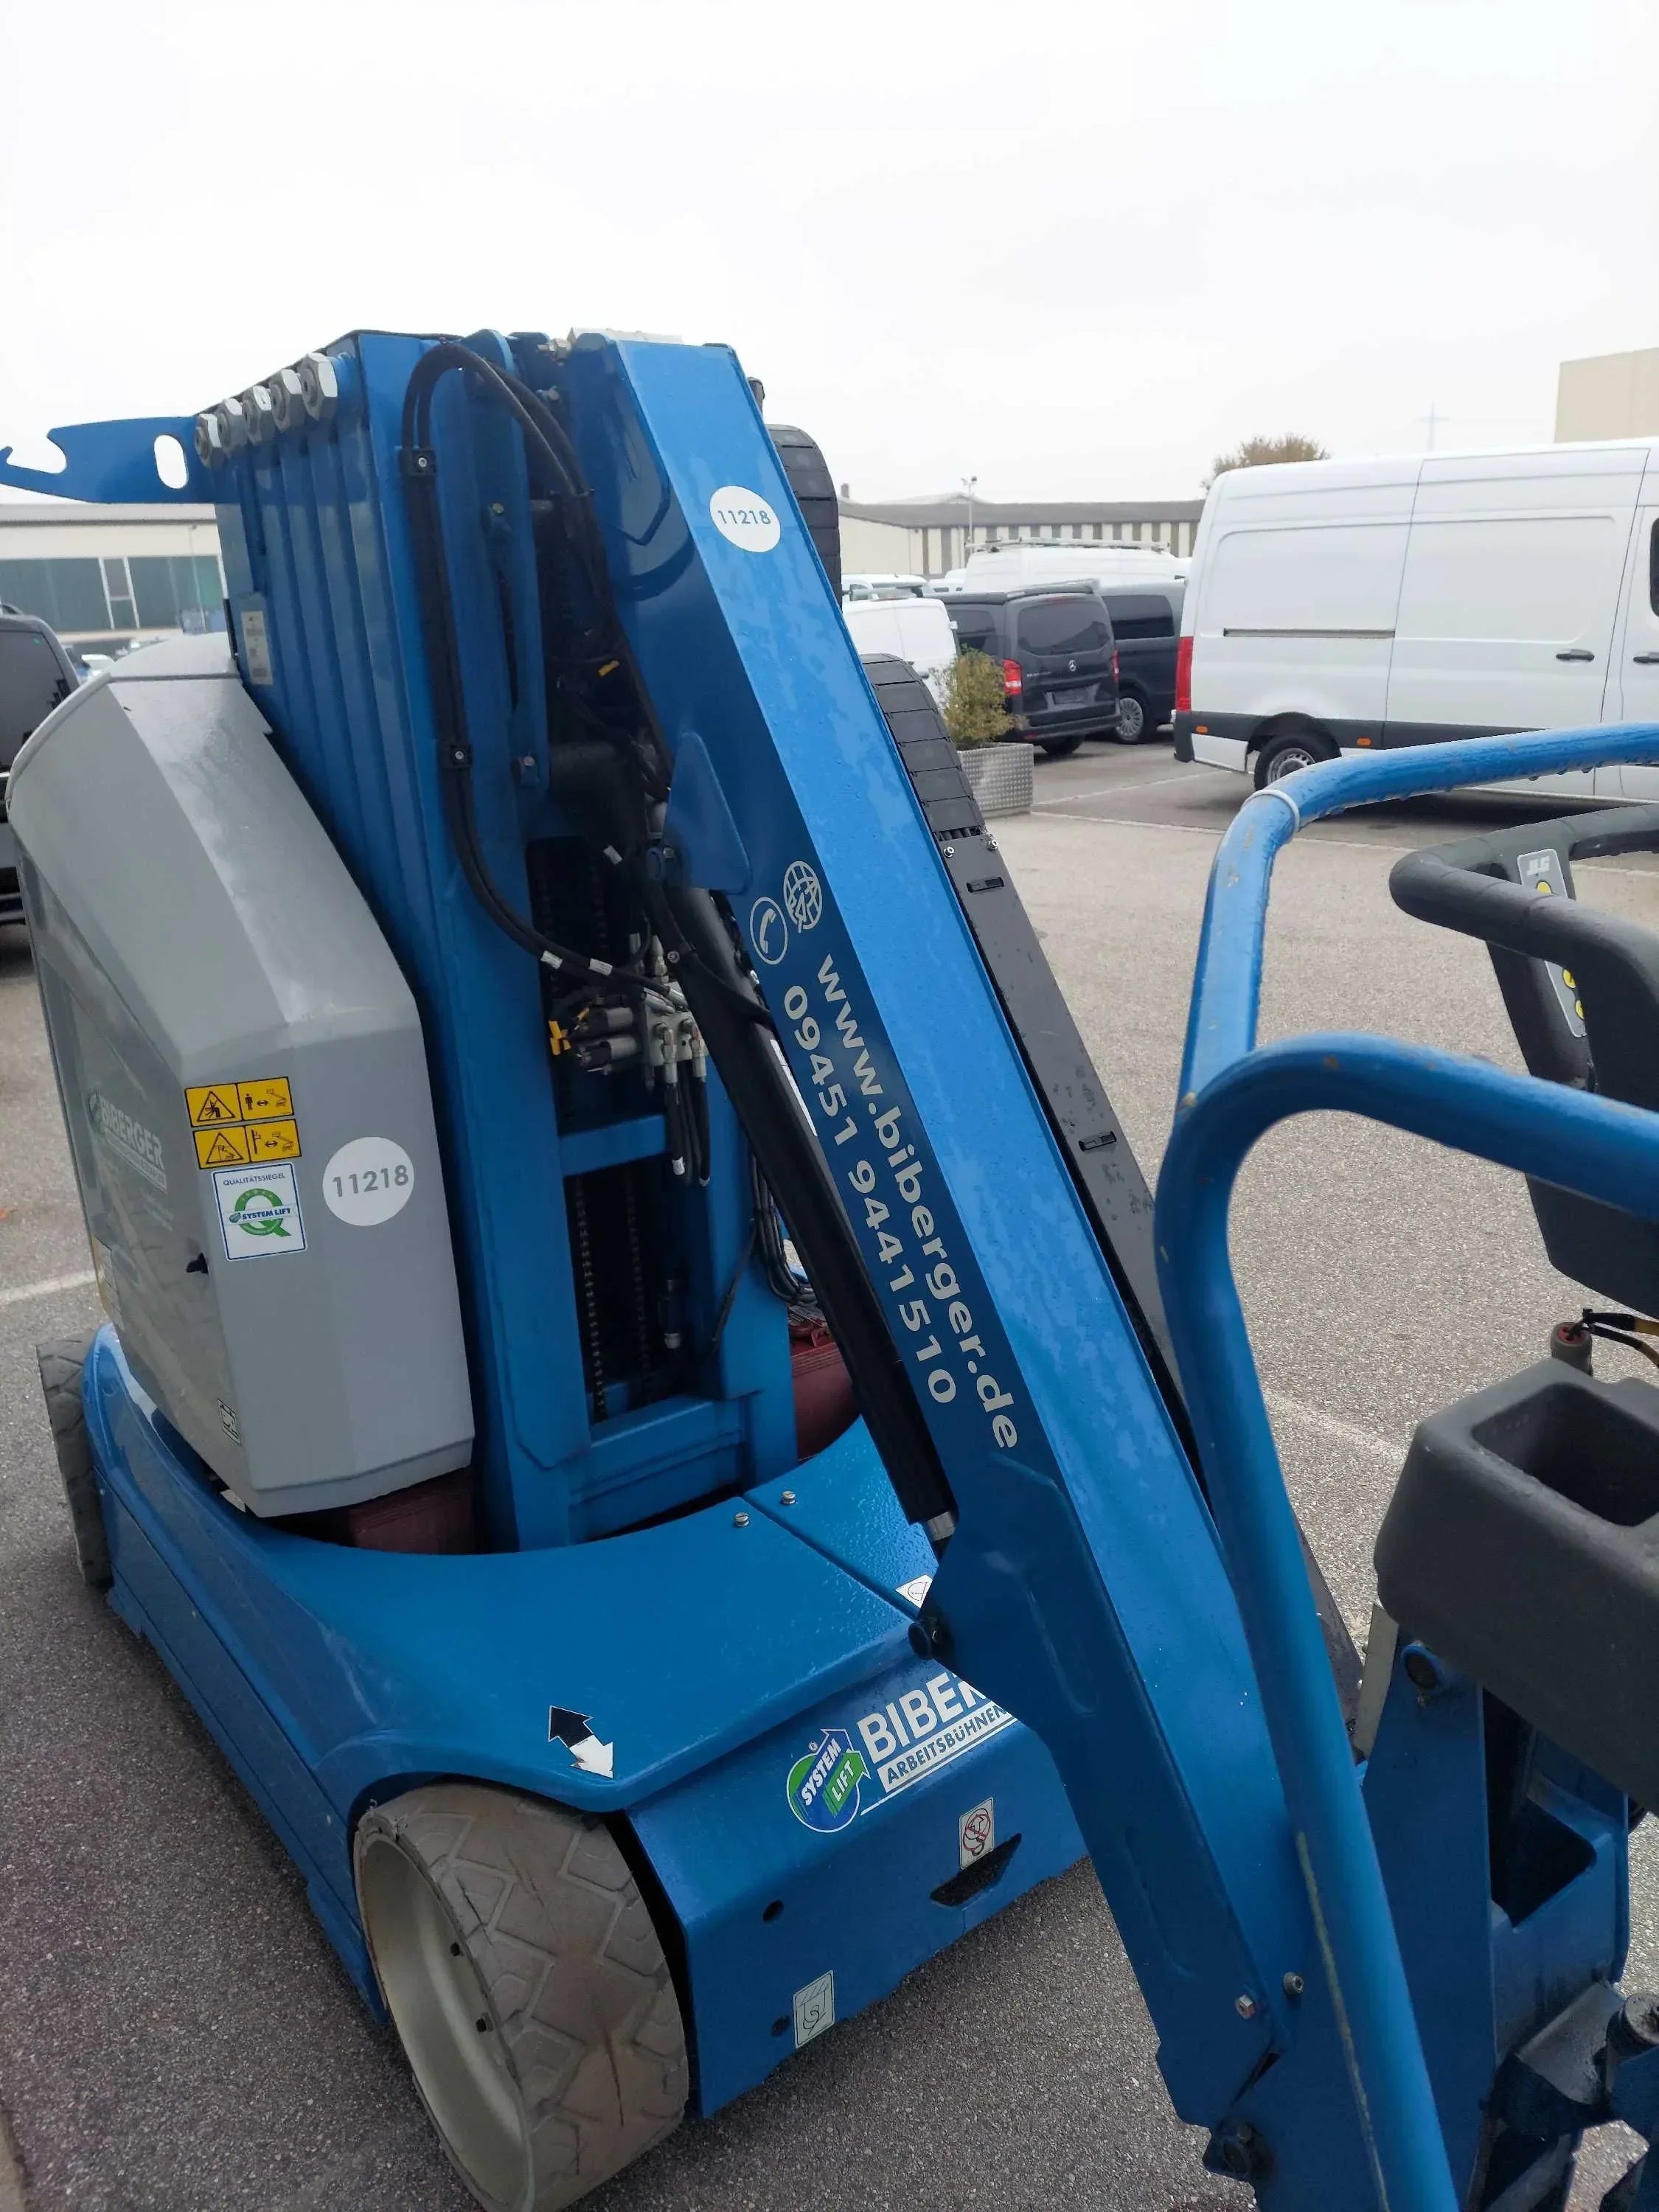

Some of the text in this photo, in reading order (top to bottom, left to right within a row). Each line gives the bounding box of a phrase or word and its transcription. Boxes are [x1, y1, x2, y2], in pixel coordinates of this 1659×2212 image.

[717, 509, 771, 524] 11218
[1527, 856, 1550, 875] JLG
[223, 1173, 286, 1186] QUALITÄTSSIEGEL
[333, 1165, 408, 1197] 11218
[784, 986, 956, 1403] 09451 9441510
[243, 1210, 274, 1220] SYSTEM
[817, 954, 1018, 1448] www.biberger.de
[801, 1738, 841, 1806] SYSTEM
[832, 1760, 854, 1801] LIFT
